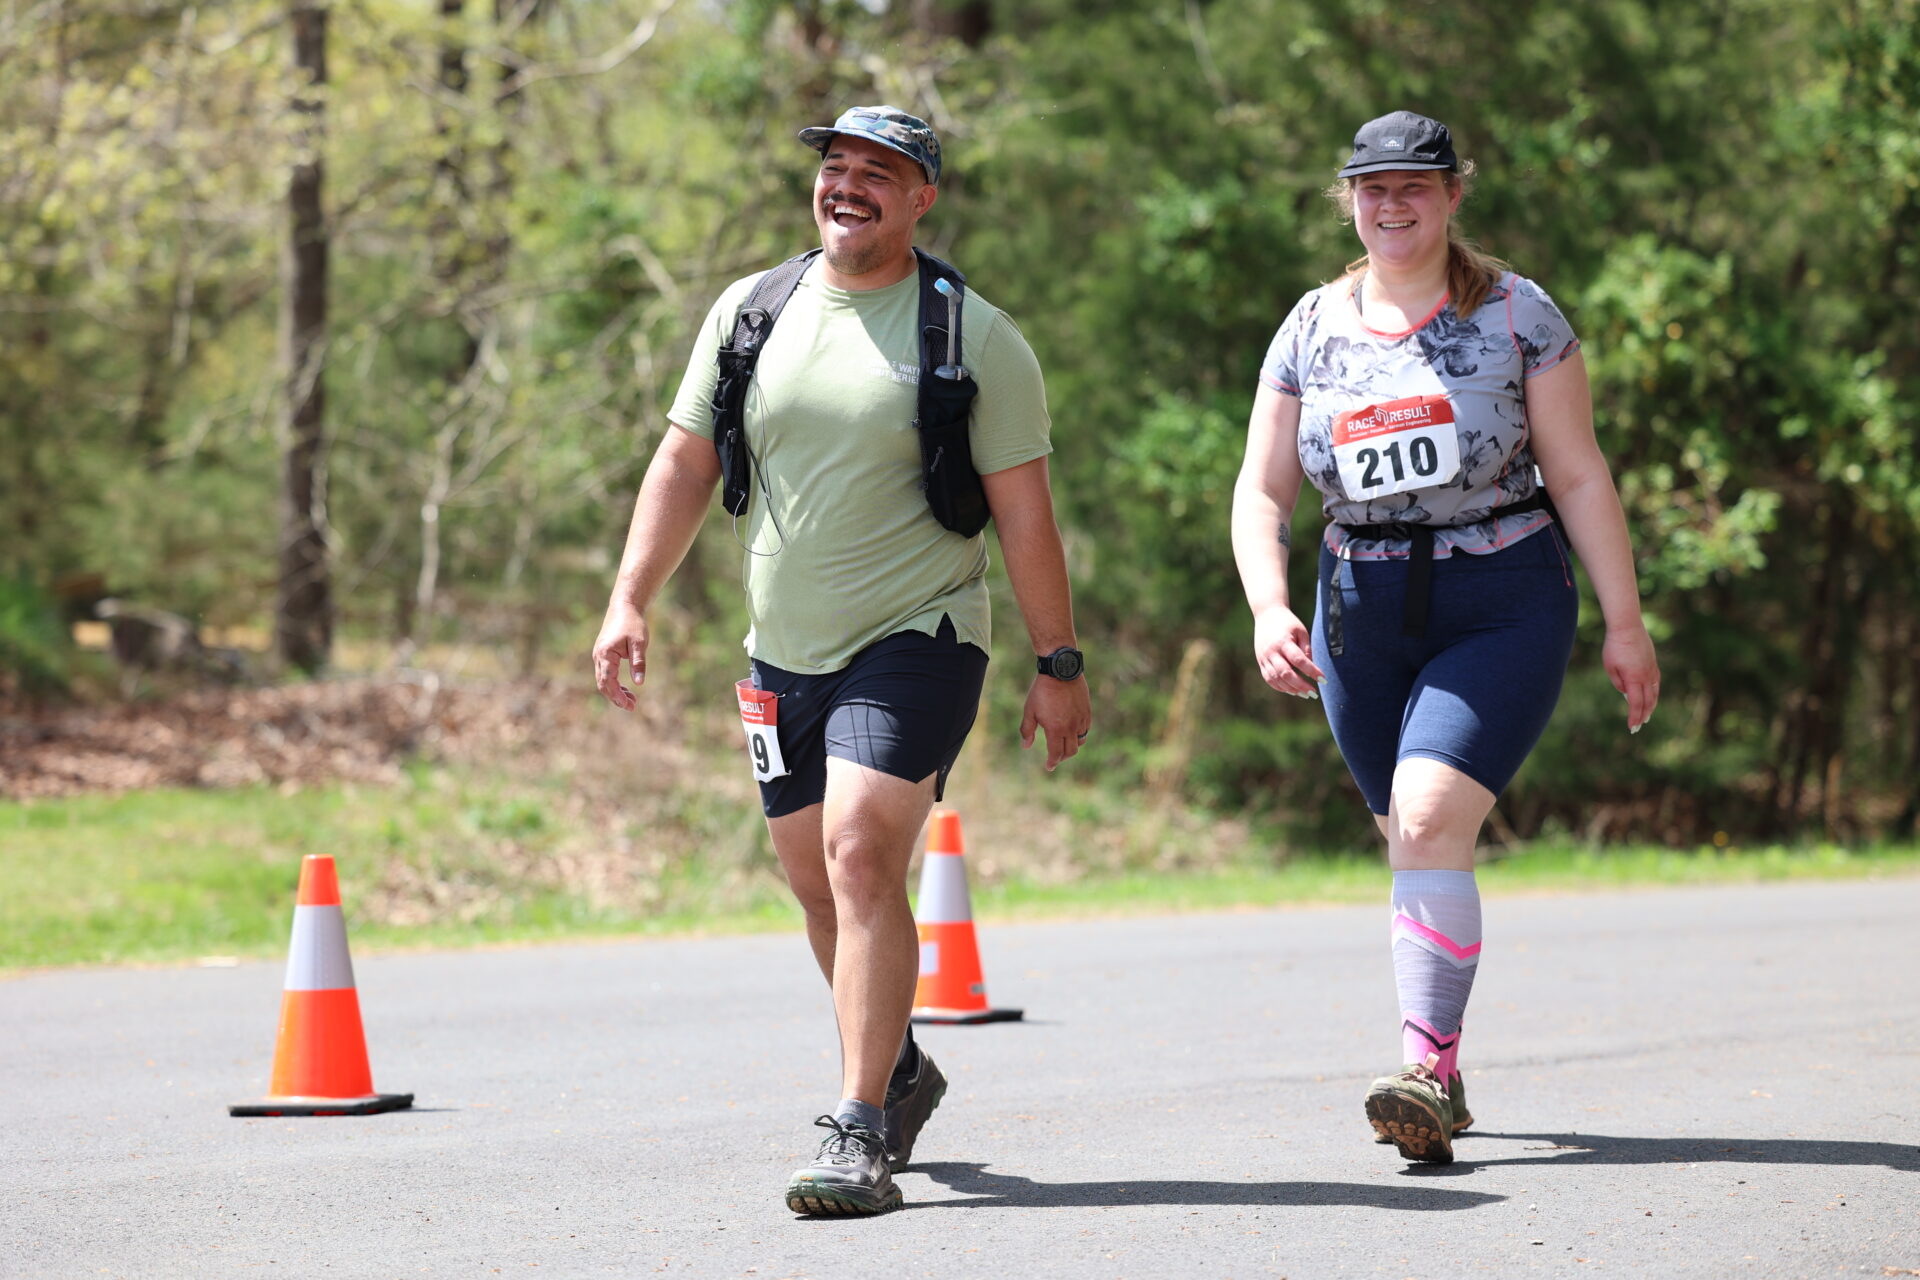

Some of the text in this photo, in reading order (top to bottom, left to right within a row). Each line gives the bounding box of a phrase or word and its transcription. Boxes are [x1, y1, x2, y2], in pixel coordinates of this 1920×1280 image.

[1347, 405, 1431, 432] RACE RESULT
[1356, 436, 1438, 489] 210
